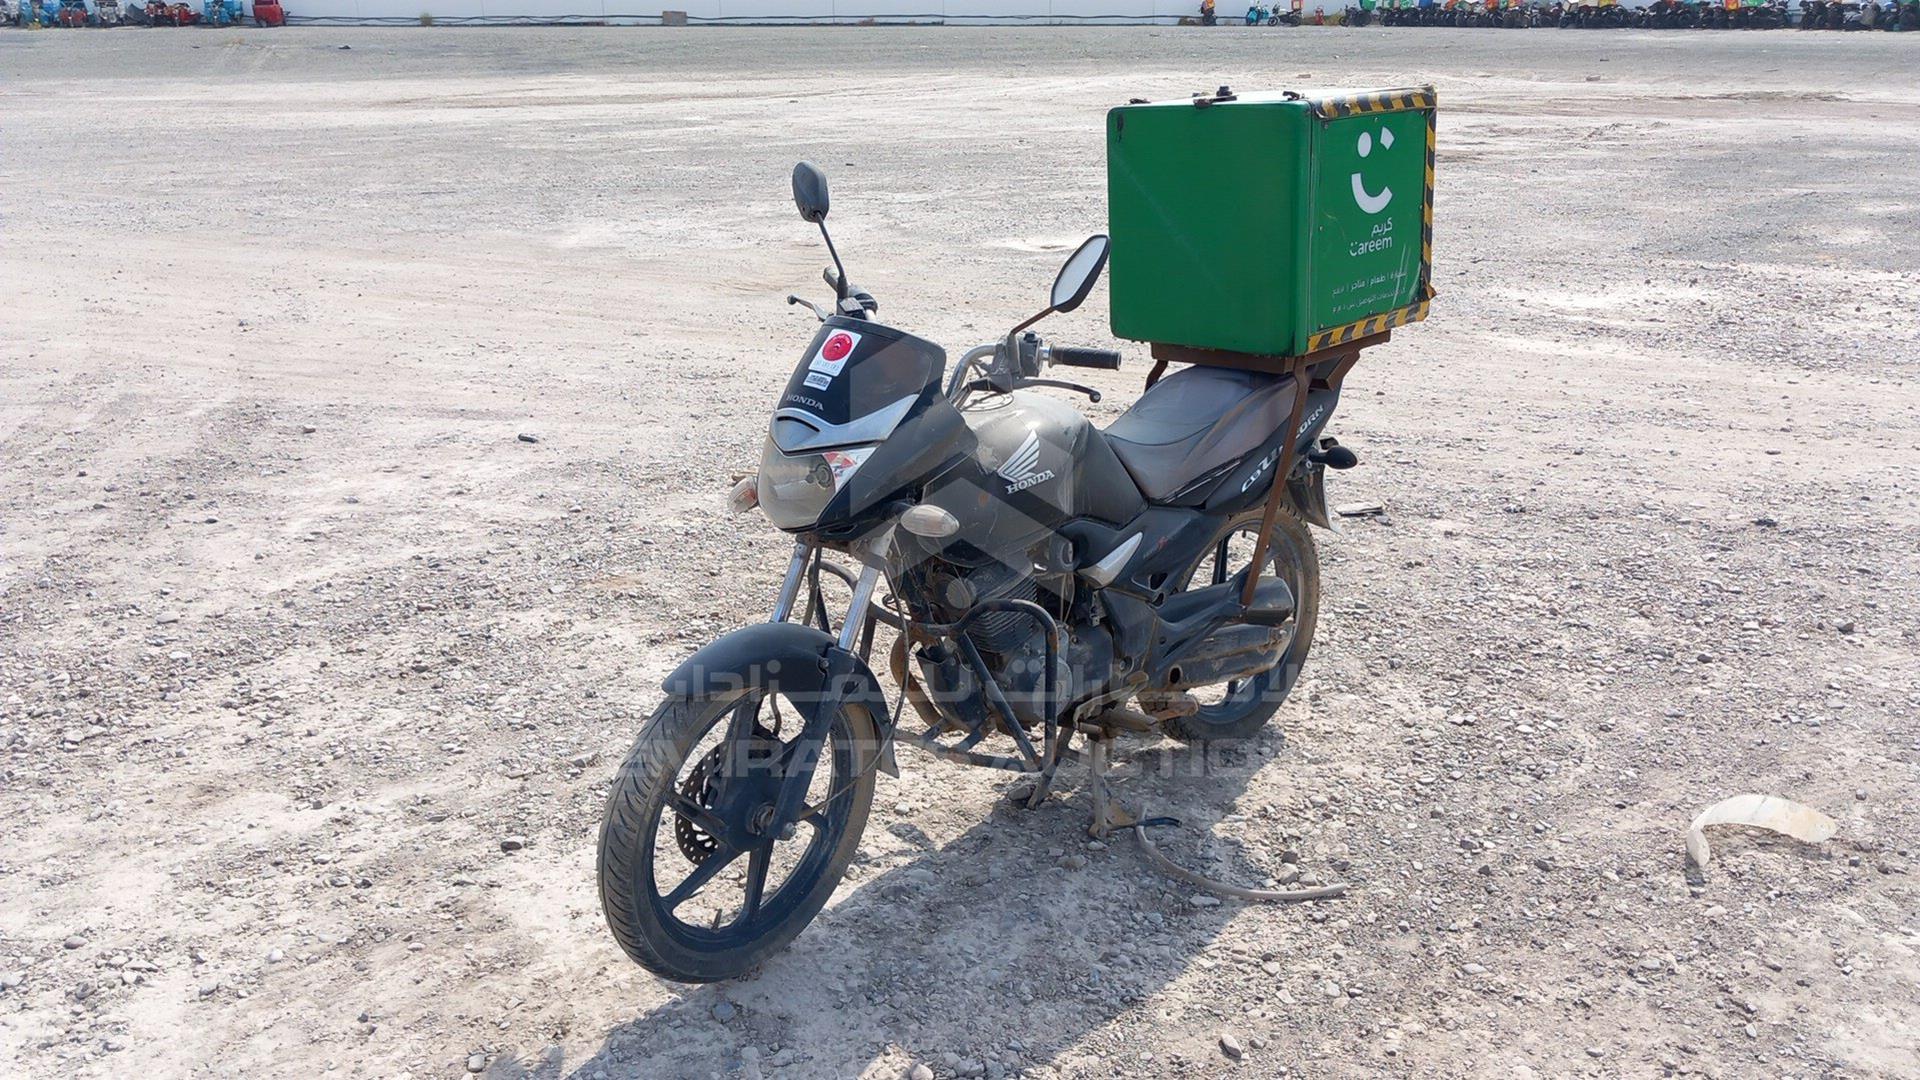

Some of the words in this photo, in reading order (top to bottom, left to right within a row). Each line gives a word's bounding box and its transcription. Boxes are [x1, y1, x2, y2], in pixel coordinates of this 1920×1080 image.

[1371, 217, 1393, 237] كريم
[1349, 236, 1393, 257] Careem
[786, 394, 824, 411] HONDA
[1005, 469, 1055, 494] HONDA
